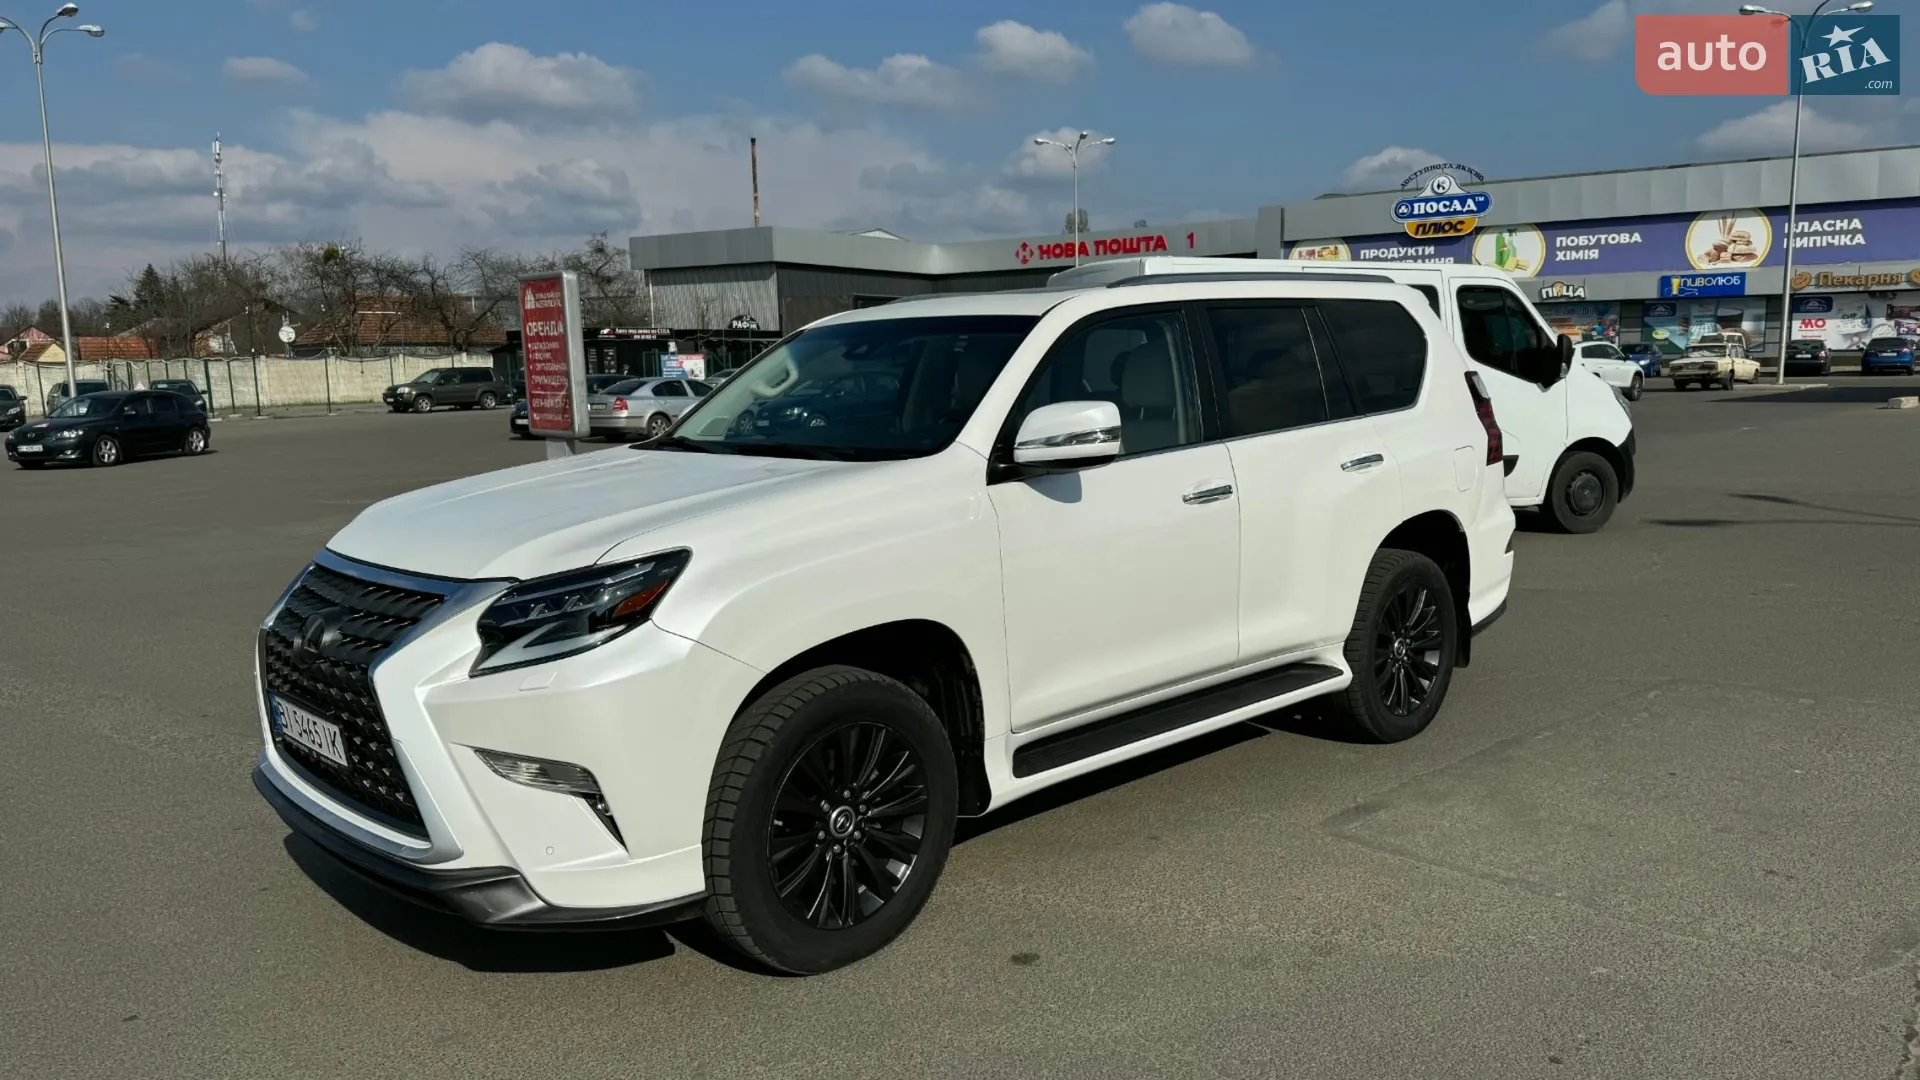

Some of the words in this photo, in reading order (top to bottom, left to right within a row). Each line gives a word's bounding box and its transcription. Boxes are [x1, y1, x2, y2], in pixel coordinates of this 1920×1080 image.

[1401, 163, 1441, 189] ДОСТУПНО
[1455, 163, 1485, 181] ЯКІСНО
[1412, 198, 1478, 215] ПОСАД
[1414, 220, 1466, 236] ПЛЮС
[1037, 241, 1090, 260] НОВА
[1094, 233, 1168, 256] ПОШТА
[1187, 232, 1196, 249] 1
[1555, 232, 1642, 248] ПОБУТОВА
[1360, 245, 1435, 259] ПРОДУКТИ
[1555, 249, 1599, 262] ХІМІЯ
[1818, 272, 1903, 289] Пекарня
[526, 321, 564, 336] ОРЕНДА
[293, 709, 323, 749] 5465
[322, 724, 343, 760] IK
